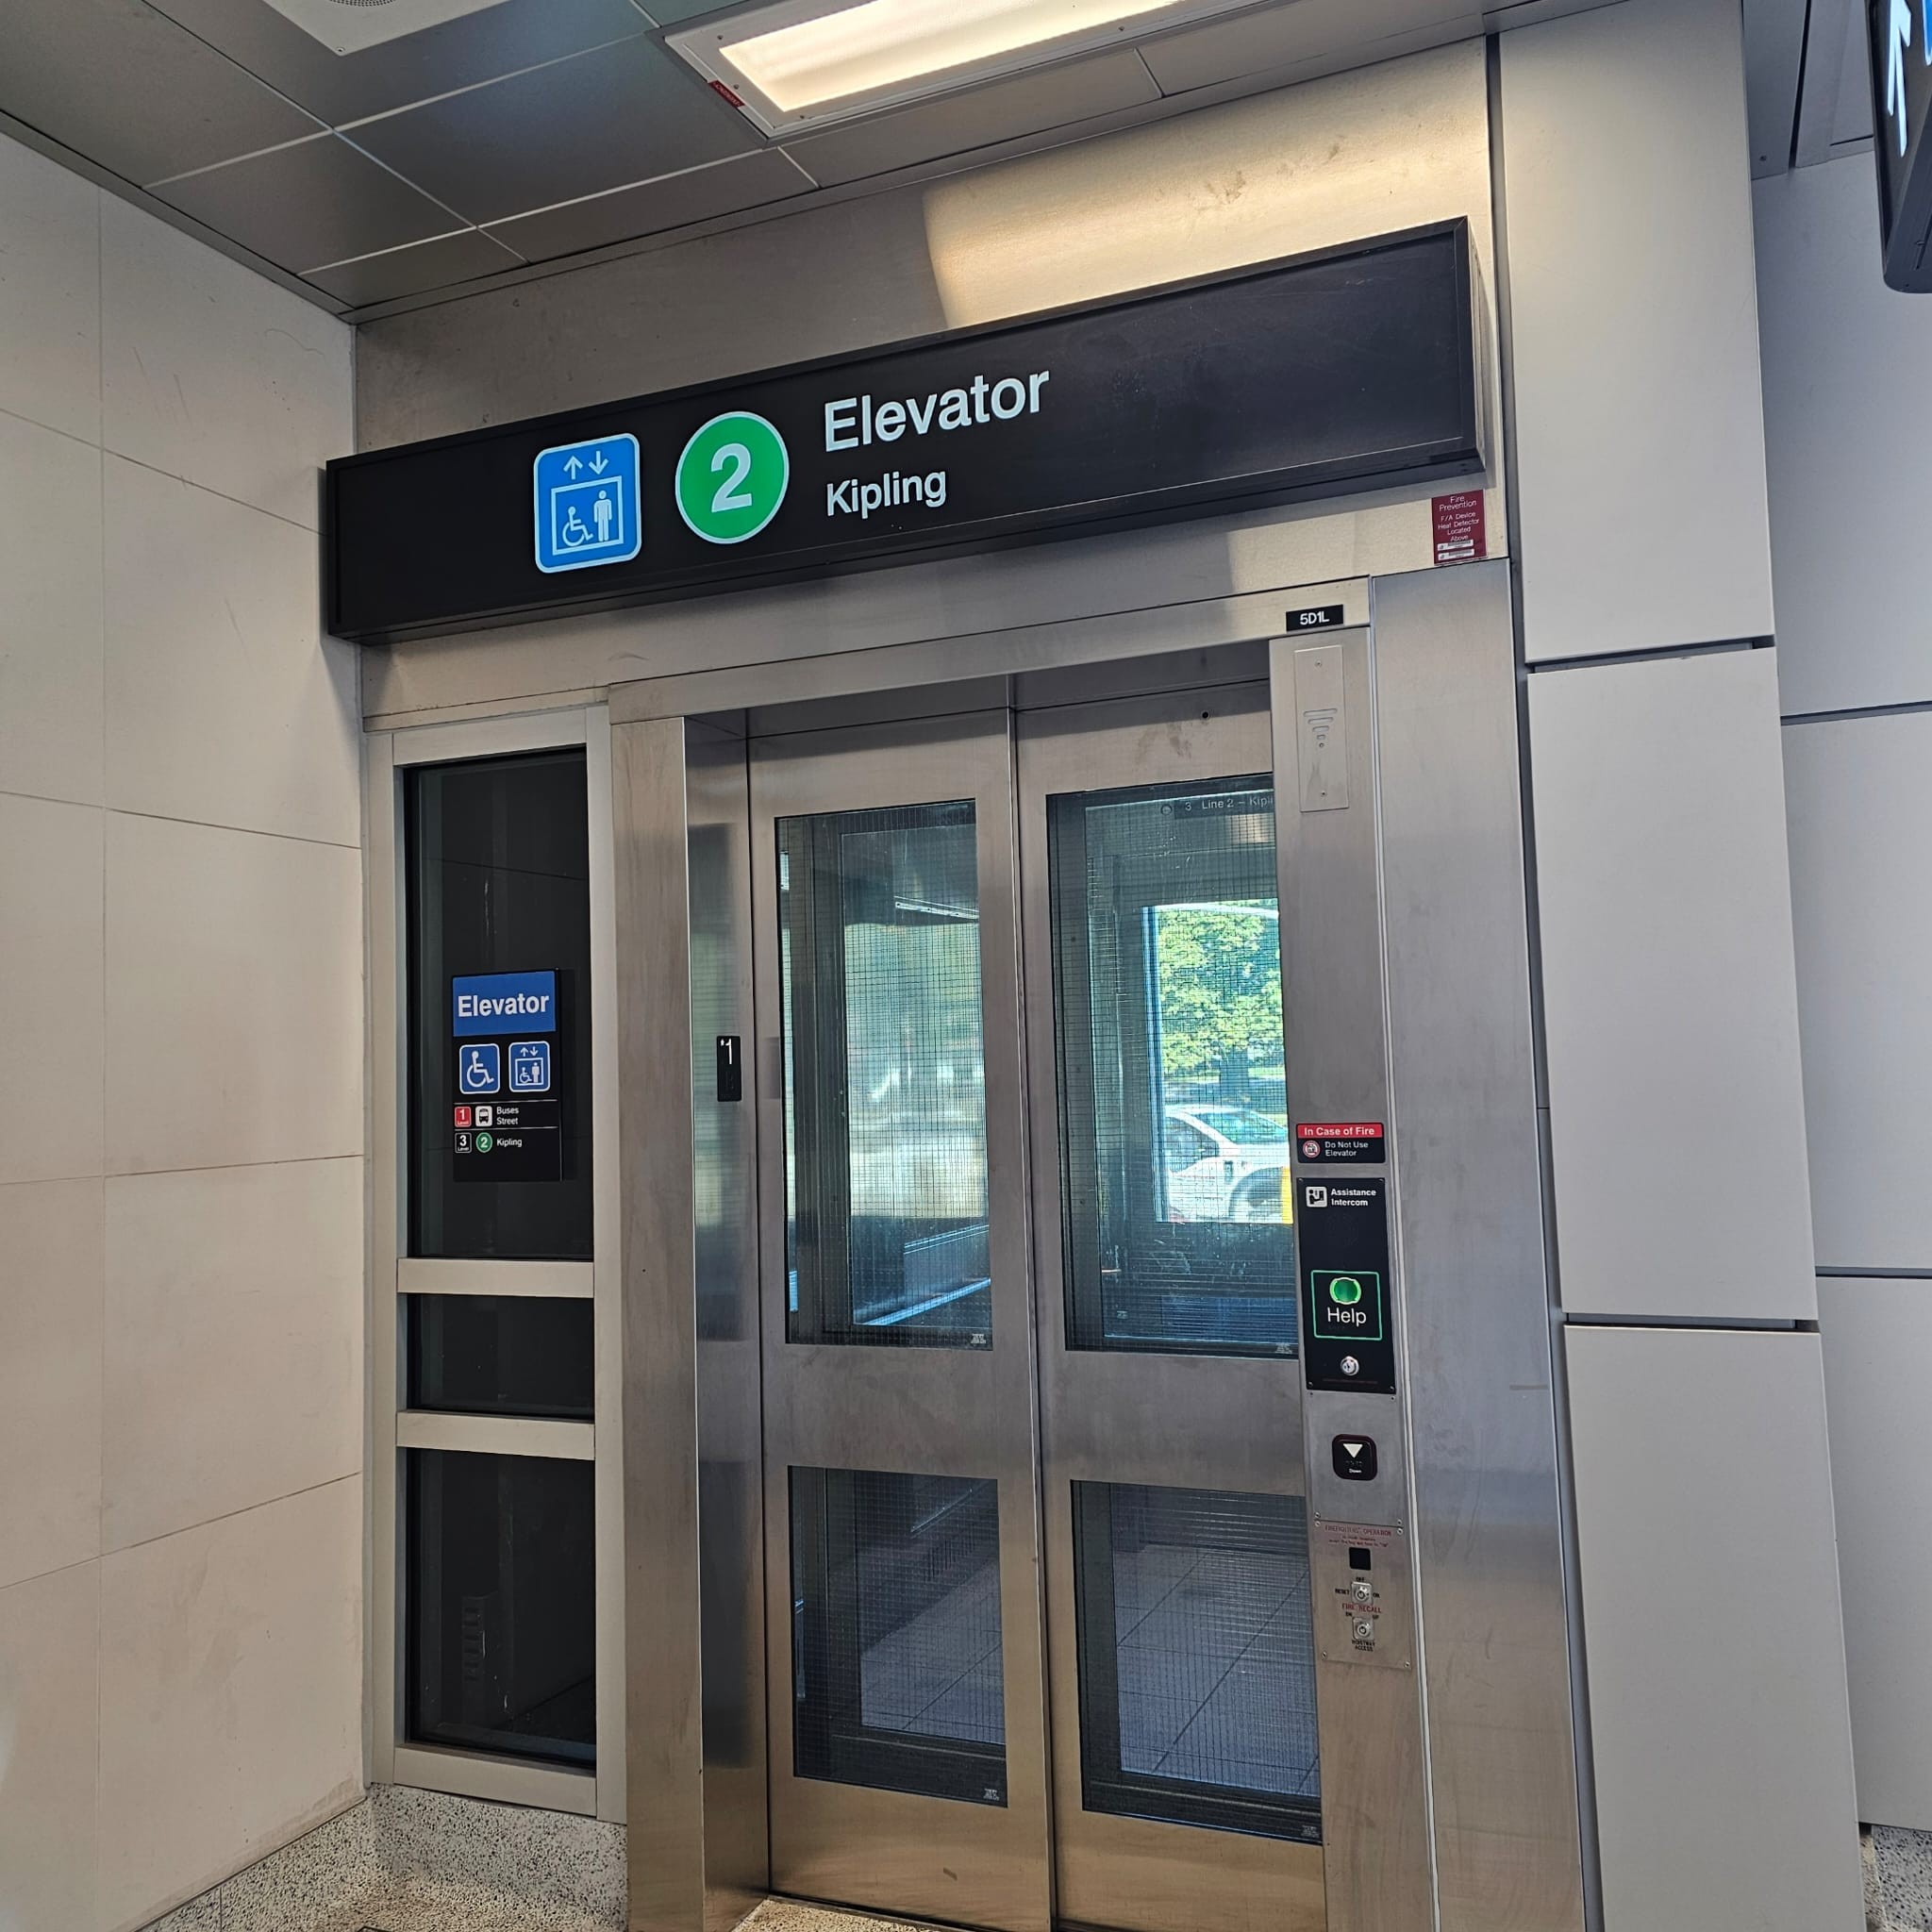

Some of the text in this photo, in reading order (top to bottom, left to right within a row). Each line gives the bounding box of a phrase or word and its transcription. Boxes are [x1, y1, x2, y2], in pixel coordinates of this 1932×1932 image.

[824, 371, 1049, 452] Elevator
[709, 442, 753, 513] 2
[826, 469, 947, 519] Kipling
[1450, 495, 1465, 504] Fire
[1439, 500, 1477, 512] Prevention
[1456, 511, 1476, 520] Device
[1454, 518, 1479, 527] Detector
[1447, 526, 1472, 536] Located
[1300, 610, 1330, 625] 5D1L
[1185, 801, 1192, 811] 3
[1202, 800, 1224, 809] Line
[1227, 798, 1235, 808] 2
[458, 993, 550, 1018] Elevator
[725, 1038, 733, 1065] 1
[459, 1108, 465, 1121] 1
[496, 1107, 520, 1115] Buses
[496, 1117, 519, 1125] Street
[1304, 1126, 1375, 1136] In Case of Fire
[459, 1135, 467, 1146] 3
[480, 1137, 489, 1148] 2
[496, 1138, 523, 1148] Kipling
[1331, 1198, 1369, 1207] Intercom
[1327, 1307, 1367, 1327] Help
